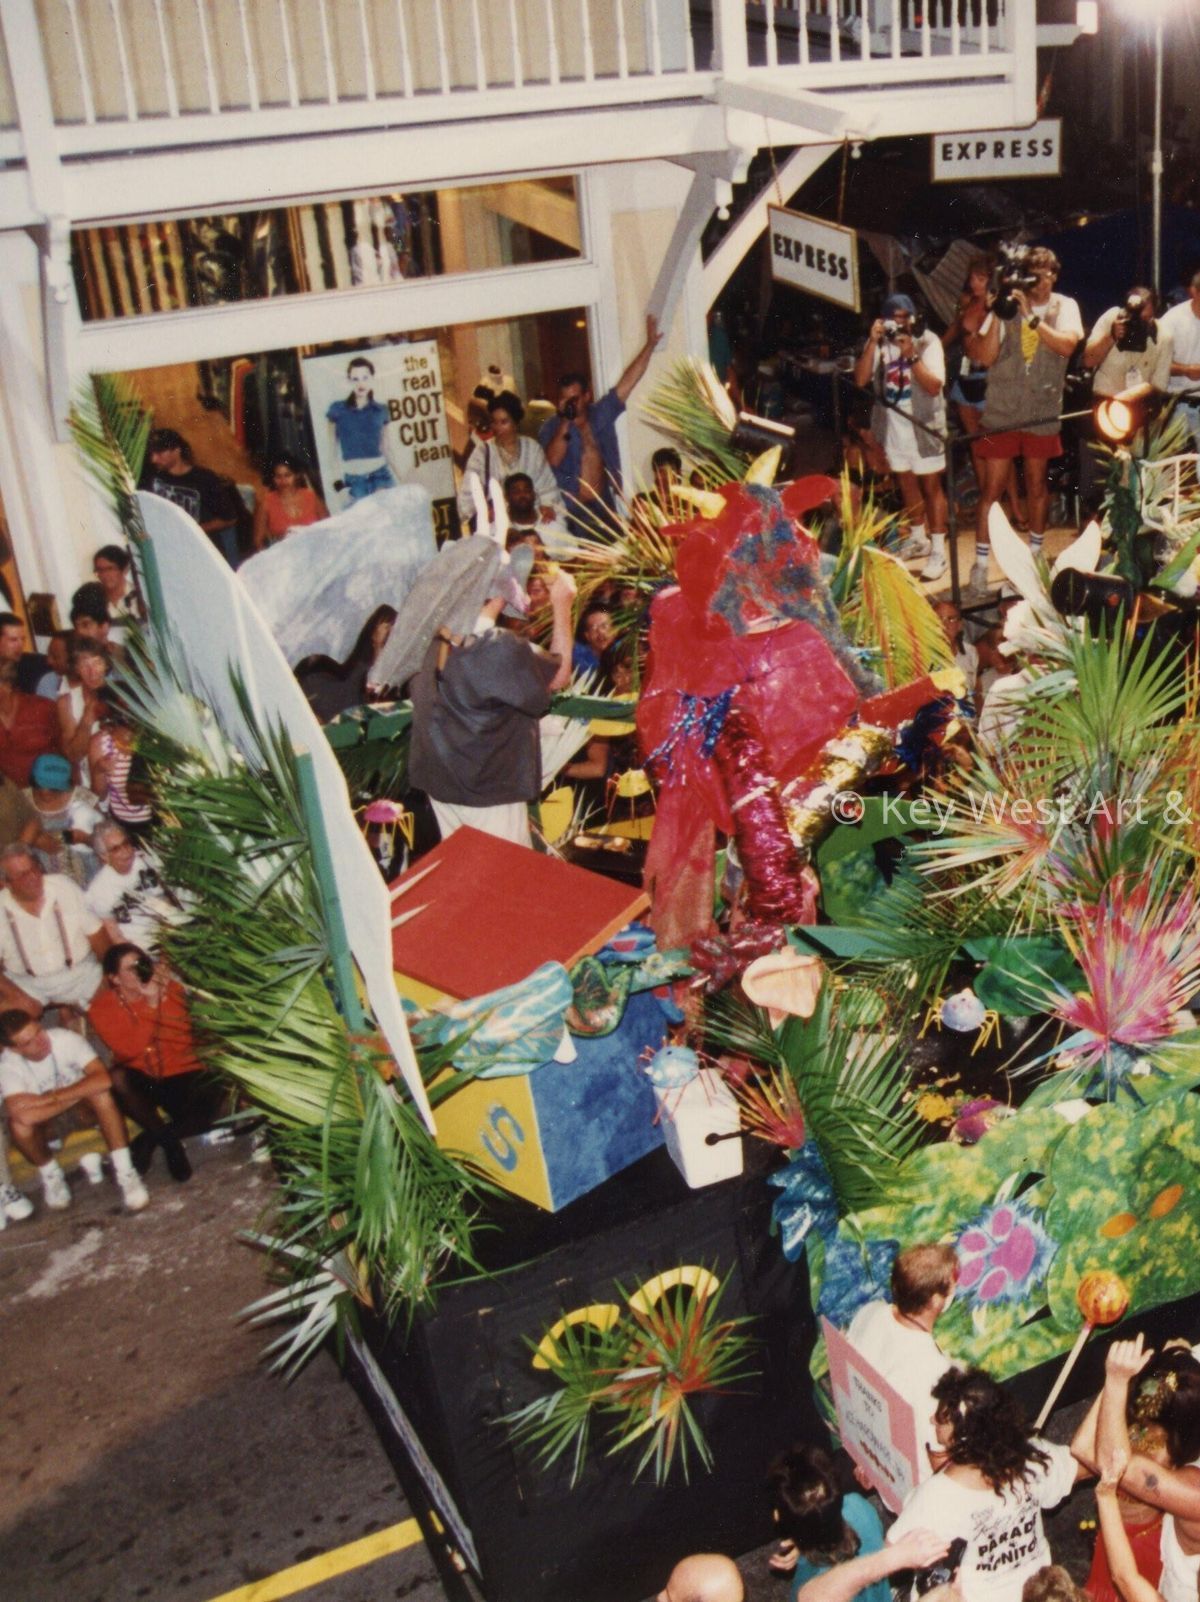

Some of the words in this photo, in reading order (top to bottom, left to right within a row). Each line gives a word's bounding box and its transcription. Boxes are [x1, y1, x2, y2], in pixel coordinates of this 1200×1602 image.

[942, 139, 1053, 162] EXPRESS
[773, 233, 849, 281] EXPRESS
[404, 355, 428, 372] the
[403, 371, 436, 393] real
[388, 392, 442, 421] BOOT
[400, 418, 439, 446] CUT
[414, 443, 450, 468] jean
[978, 1511, 1037, 1557] PARAD
